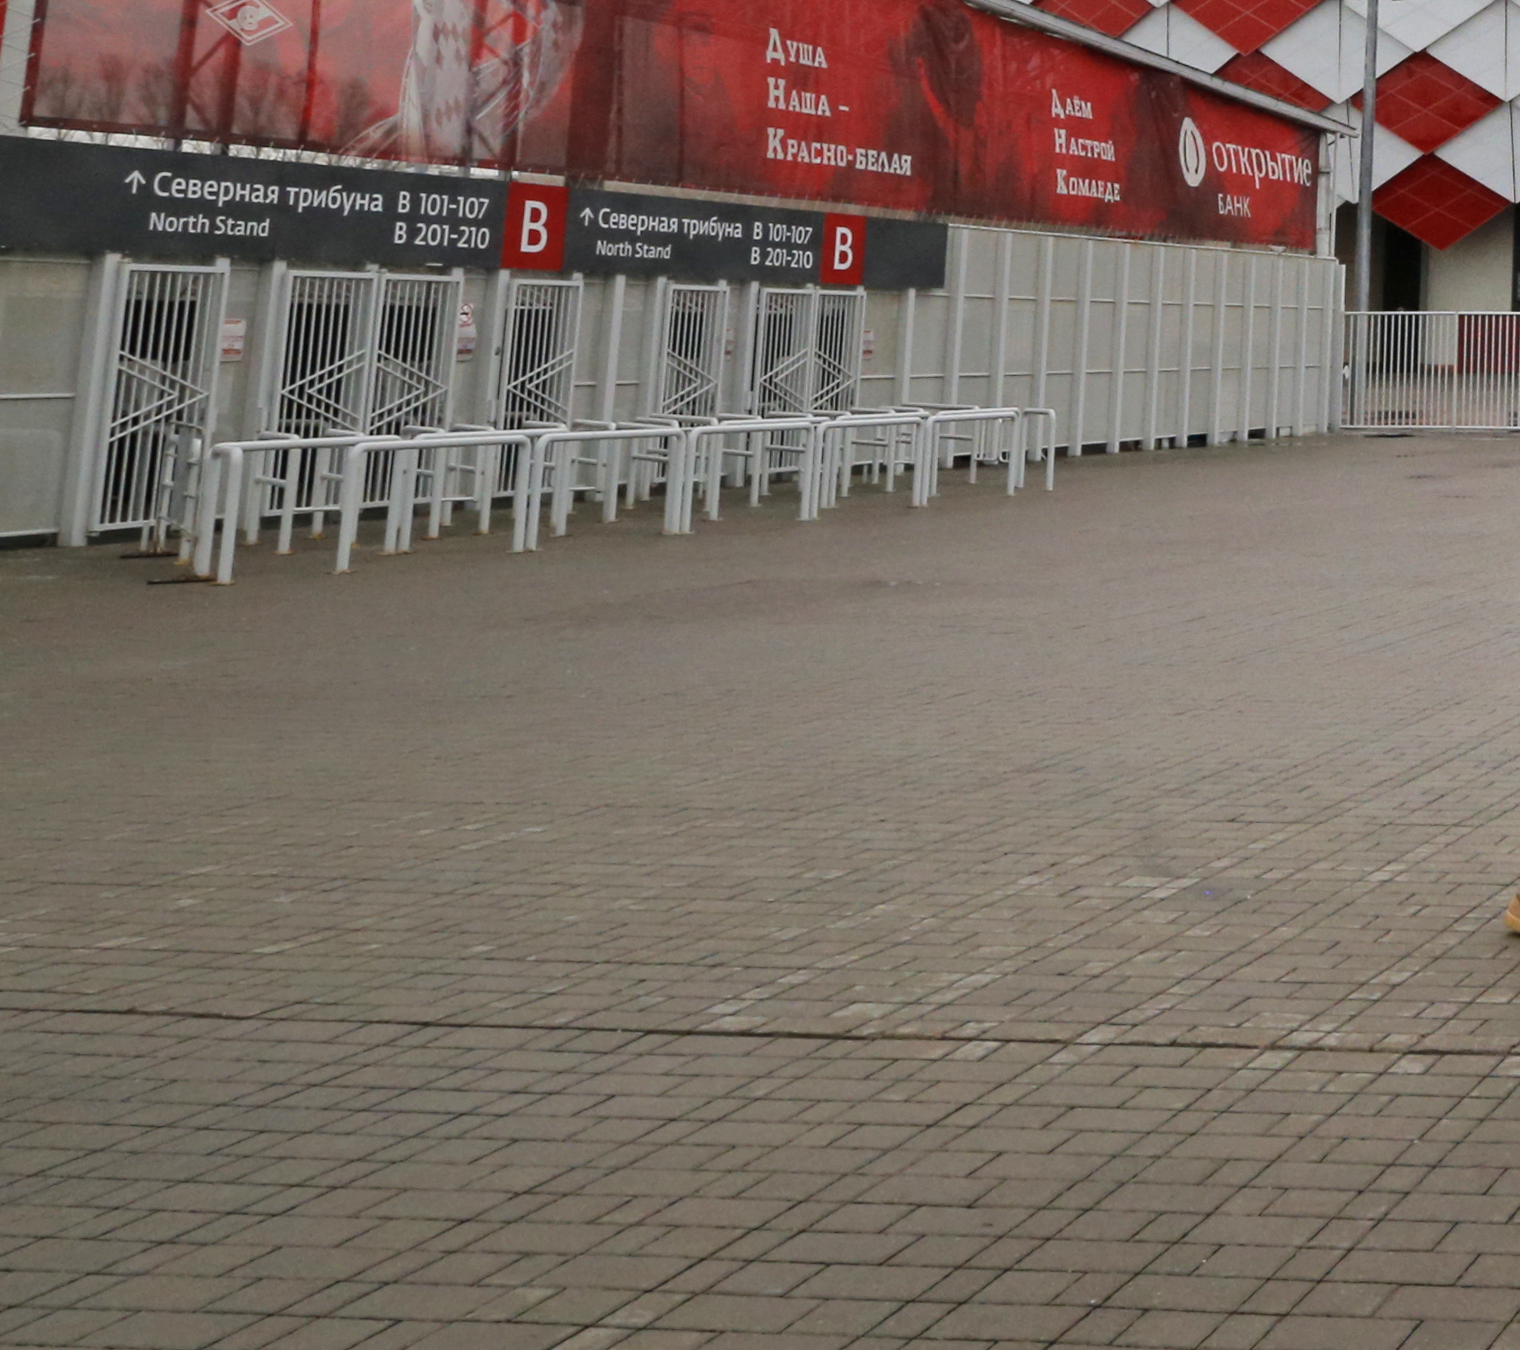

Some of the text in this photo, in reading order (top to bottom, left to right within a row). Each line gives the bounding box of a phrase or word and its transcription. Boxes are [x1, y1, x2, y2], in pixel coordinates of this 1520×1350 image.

[766, 27, 828, 68] ДУША
[767, 77, 831, 117] НАША
[1051, 89, 1093, 119] ДАЁМ
[766, 127, 912, 176] КРАСНО-БЕЛАЯ
[1054, 128, 1116, 162] НАСТРОЙ
[1212, 141, 1312, 189] открытие
[153, 171, 278, 206] Северная
[286, 183, 383, 216] трибуна
[419, 192, 489, 219] 101-107
[1218, 193, 1251, 217] БАНК
[149, 212, 270, 237] North Stand
[414, 223, 490, 249] 201-210
[520, 199, 549, 253] B
[598, 208, 678, 232] Северная
[682, 216, 742, 241] трибуна
[768, 223, 813, 244] 101-107
[596, 240, 672, 259] North Stand
[765, 248, 813, 269] 201-210
[833, 226, 853, 271] B
